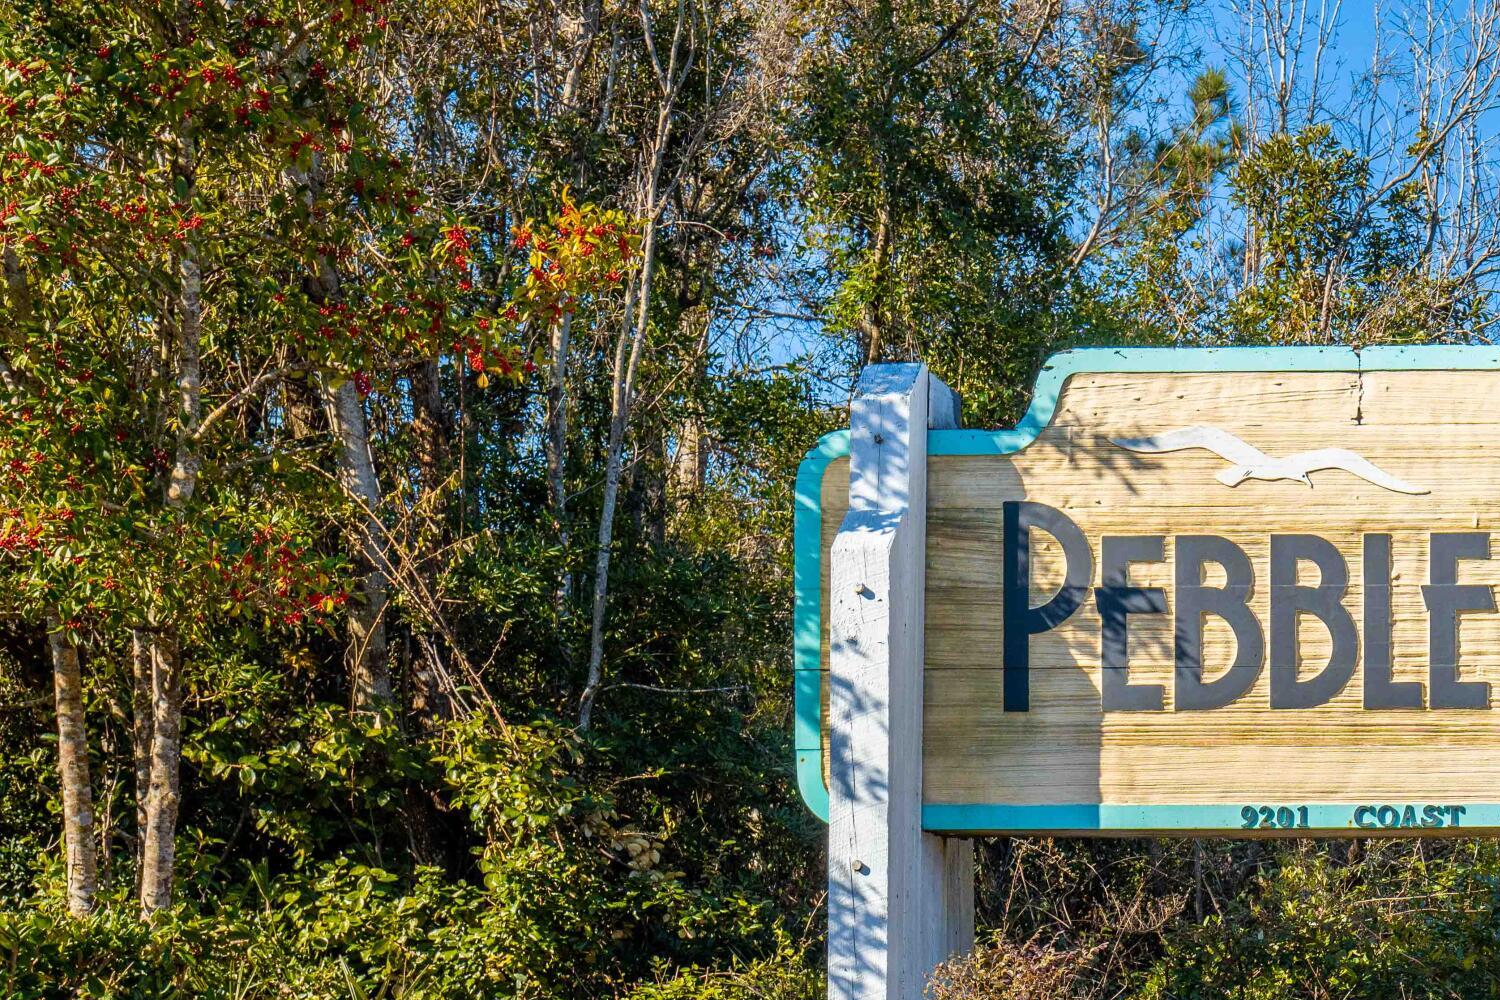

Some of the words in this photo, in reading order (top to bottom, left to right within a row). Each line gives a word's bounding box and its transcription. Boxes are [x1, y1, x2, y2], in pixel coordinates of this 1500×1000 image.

[1002, 499, 1497, 713] PEBBLE
[1240, 804, 1310, 829] 9201
[1353, 804, 1467, 829] COAST
